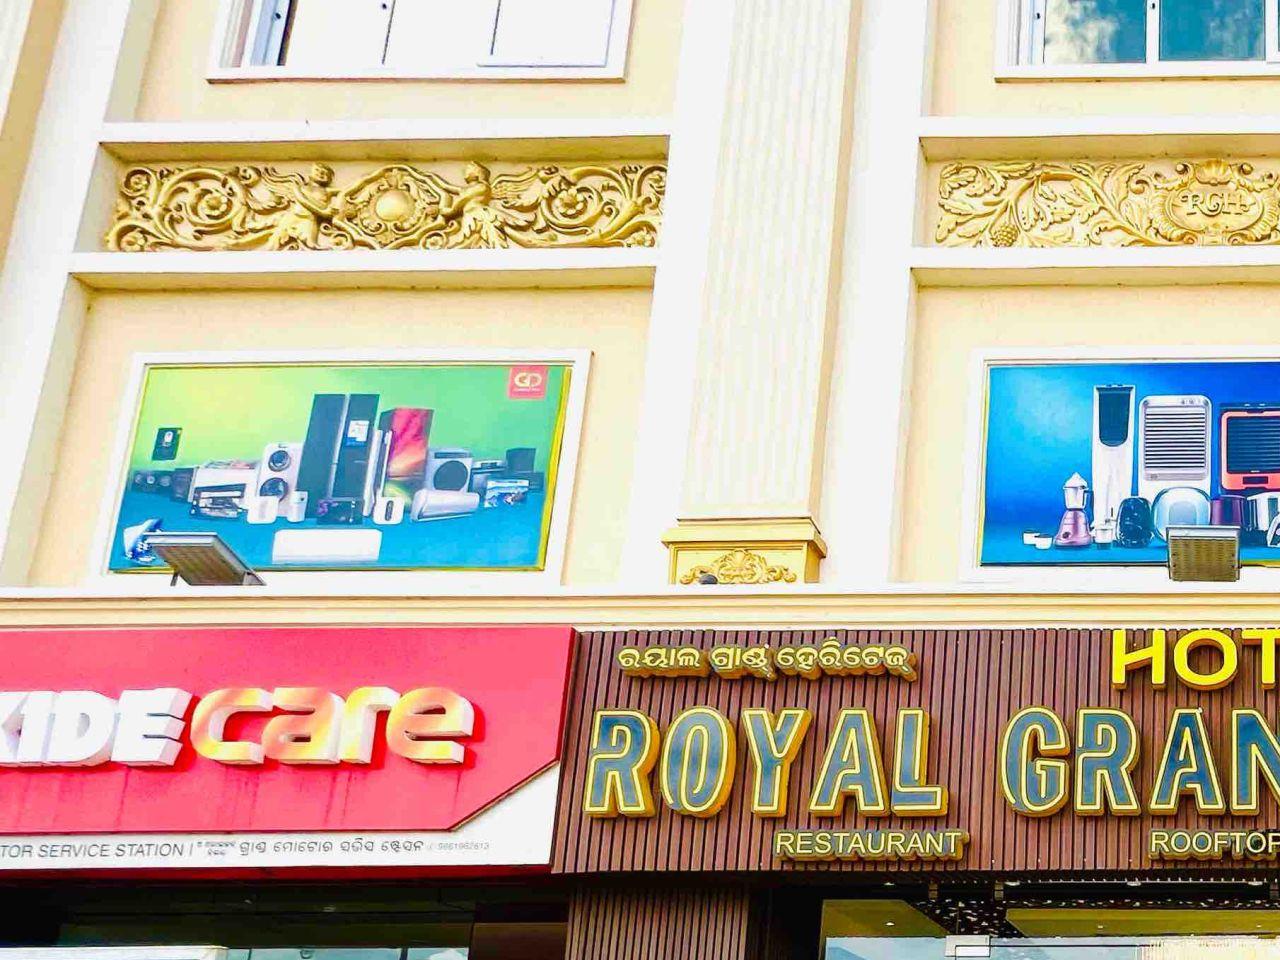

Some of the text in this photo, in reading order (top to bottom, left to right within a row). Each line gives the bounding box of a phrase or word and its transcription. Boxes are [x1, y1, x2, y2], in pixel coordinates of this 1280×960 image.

[190, 686, 476, 765] care
[584, 706, 950, 817] ROYAL
[37, 844, 110, 858] SERVICE
[115, 843, 184, 857] STATION
[775, 831, 967, 857] RESTAURANT
